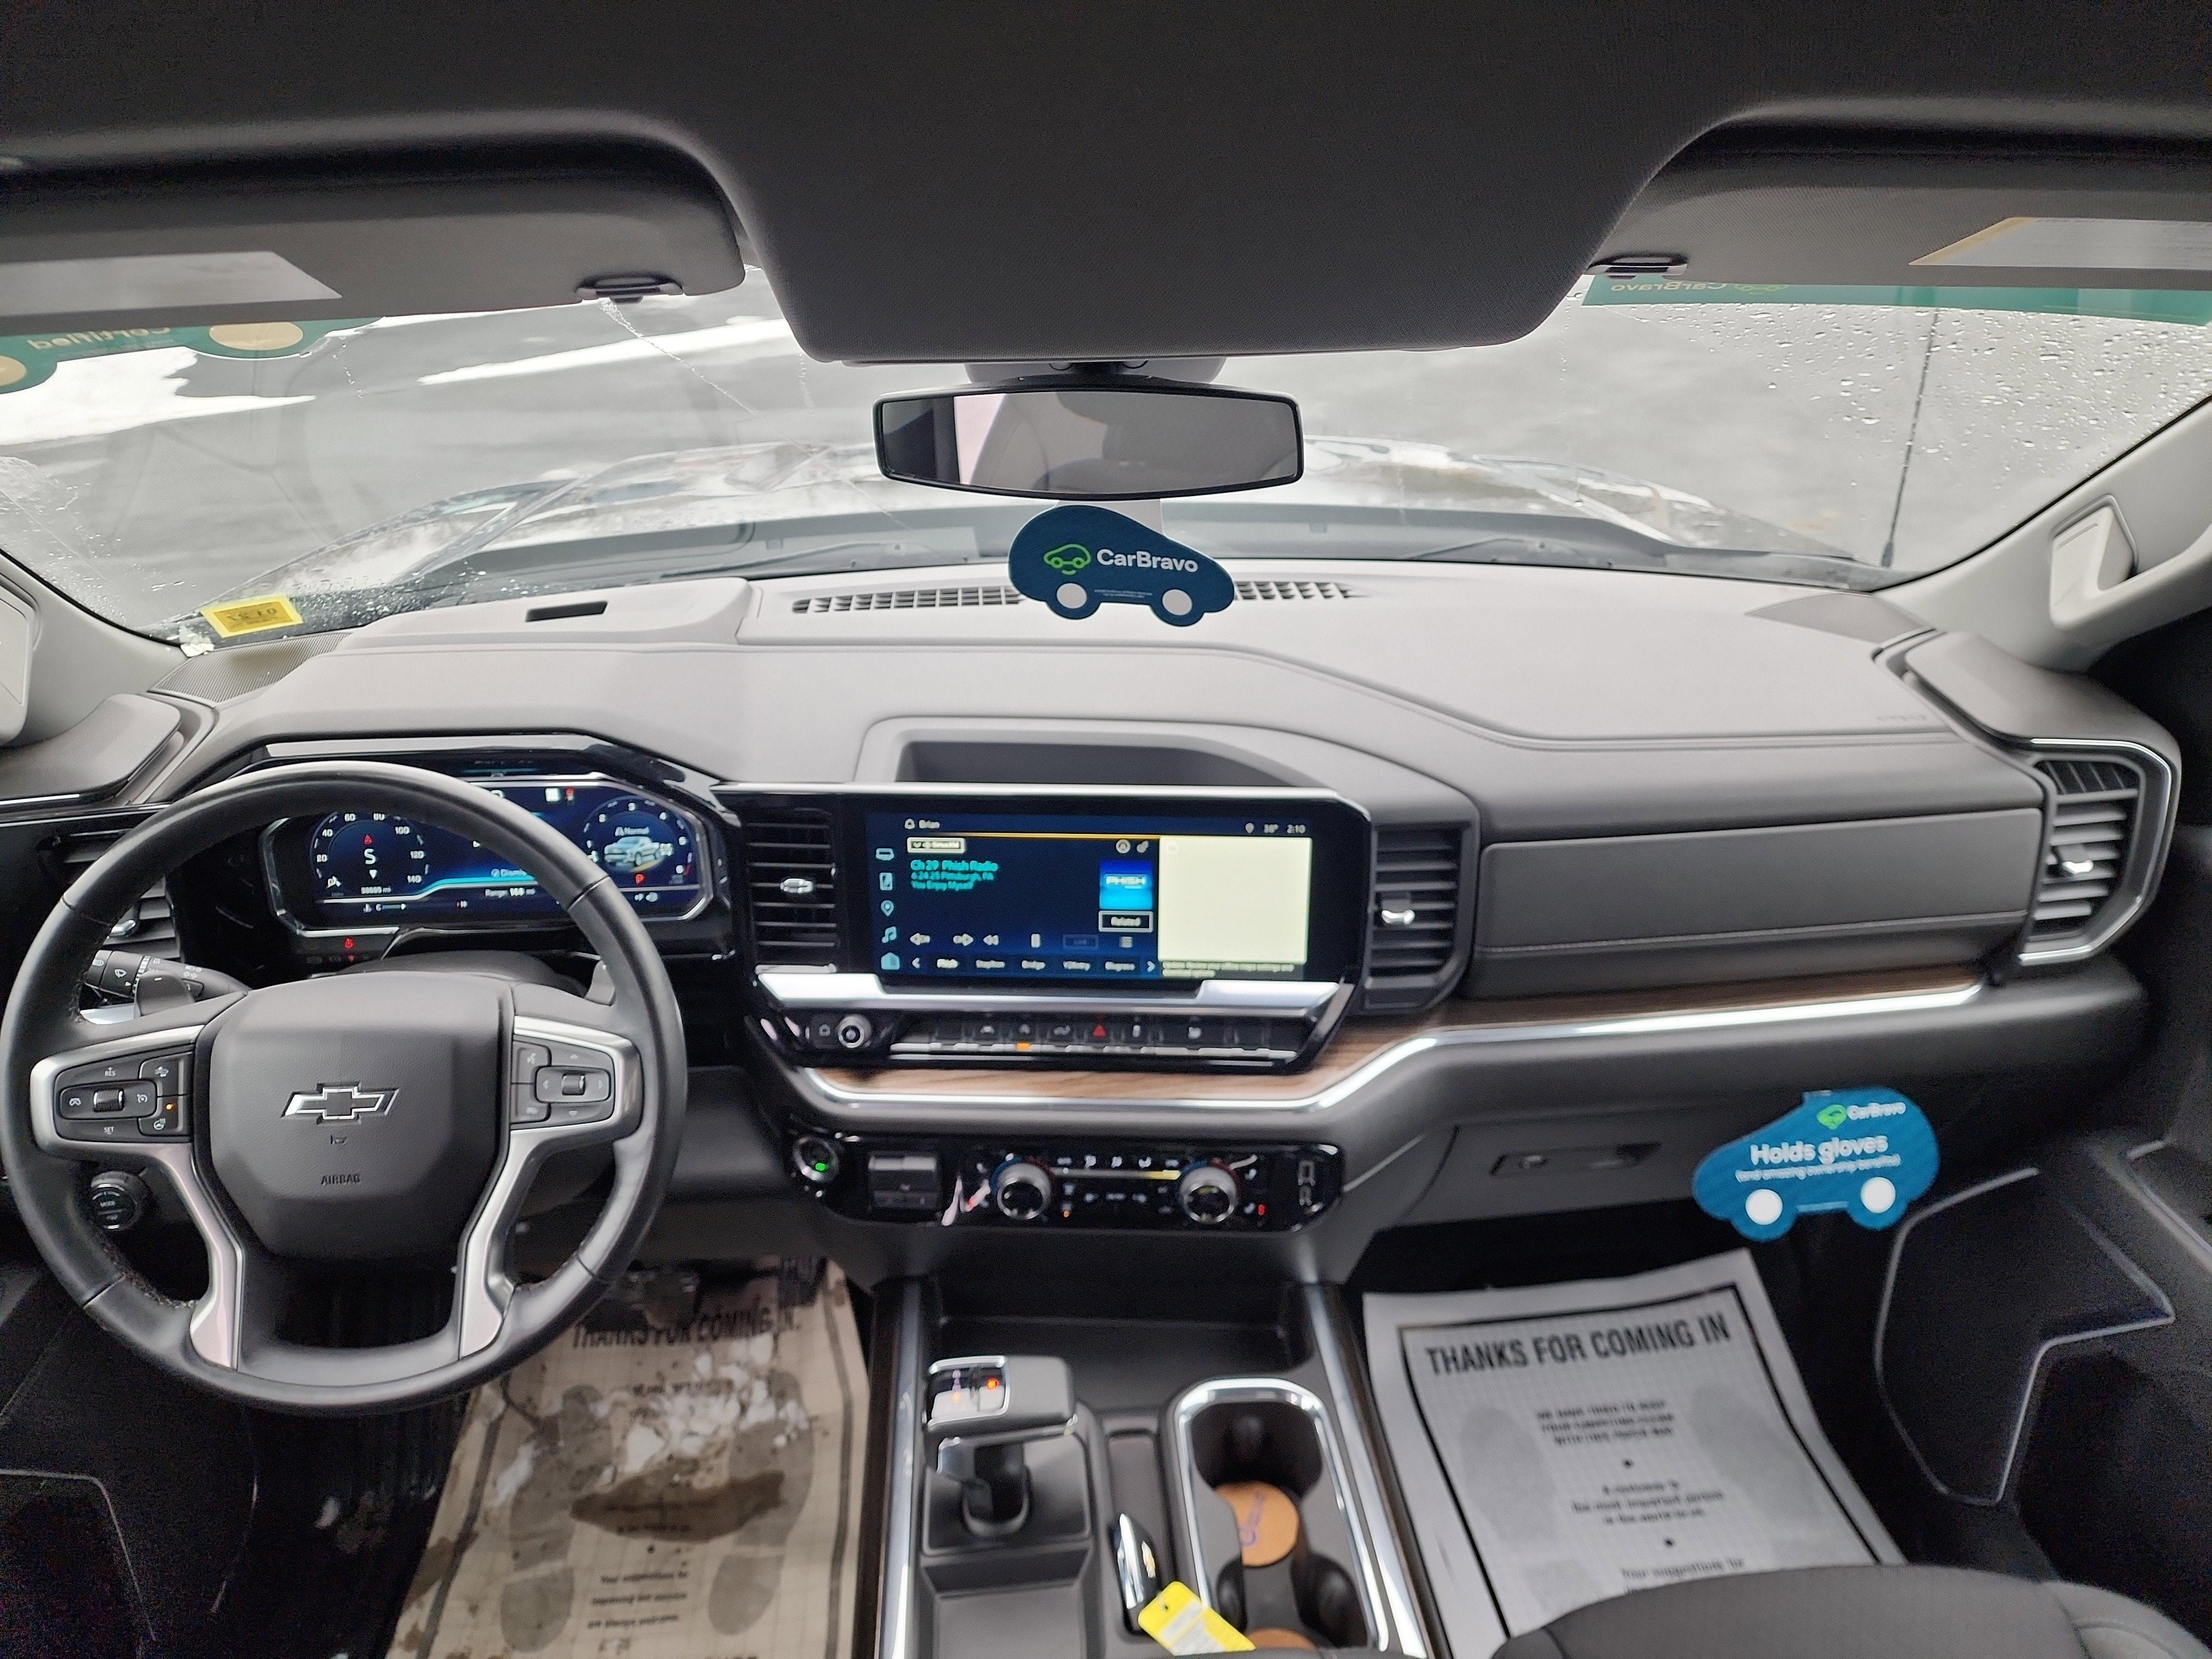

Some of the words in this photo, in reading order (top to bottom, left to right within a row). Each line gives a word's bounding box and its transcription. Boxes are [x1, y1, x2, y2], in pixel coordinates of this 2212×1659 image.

[1096, 549, 1198, 572] CarBravo
[395, 826, 410, 834] 100
[364, 848, 377, 864] S
[410, 851, 425, 859] 120
[911, 859, 925, 870] Ch
[970, 860, 999, 872] Radio
[407, 875, 422, 884] 140
[1750, 1141, 1815, 1165] Holds
[1818, 1136, 1888, 1165] gloves
[321, 1173, 361, 1186] AIRBAG
[1425, 1338, 1528, 1375] THANKS
[1531, 1331, 1588, 1363] FOR
[1589, 1319, 1696, 1359] COMING
[1697, 1312, 1733, 1343] IN
